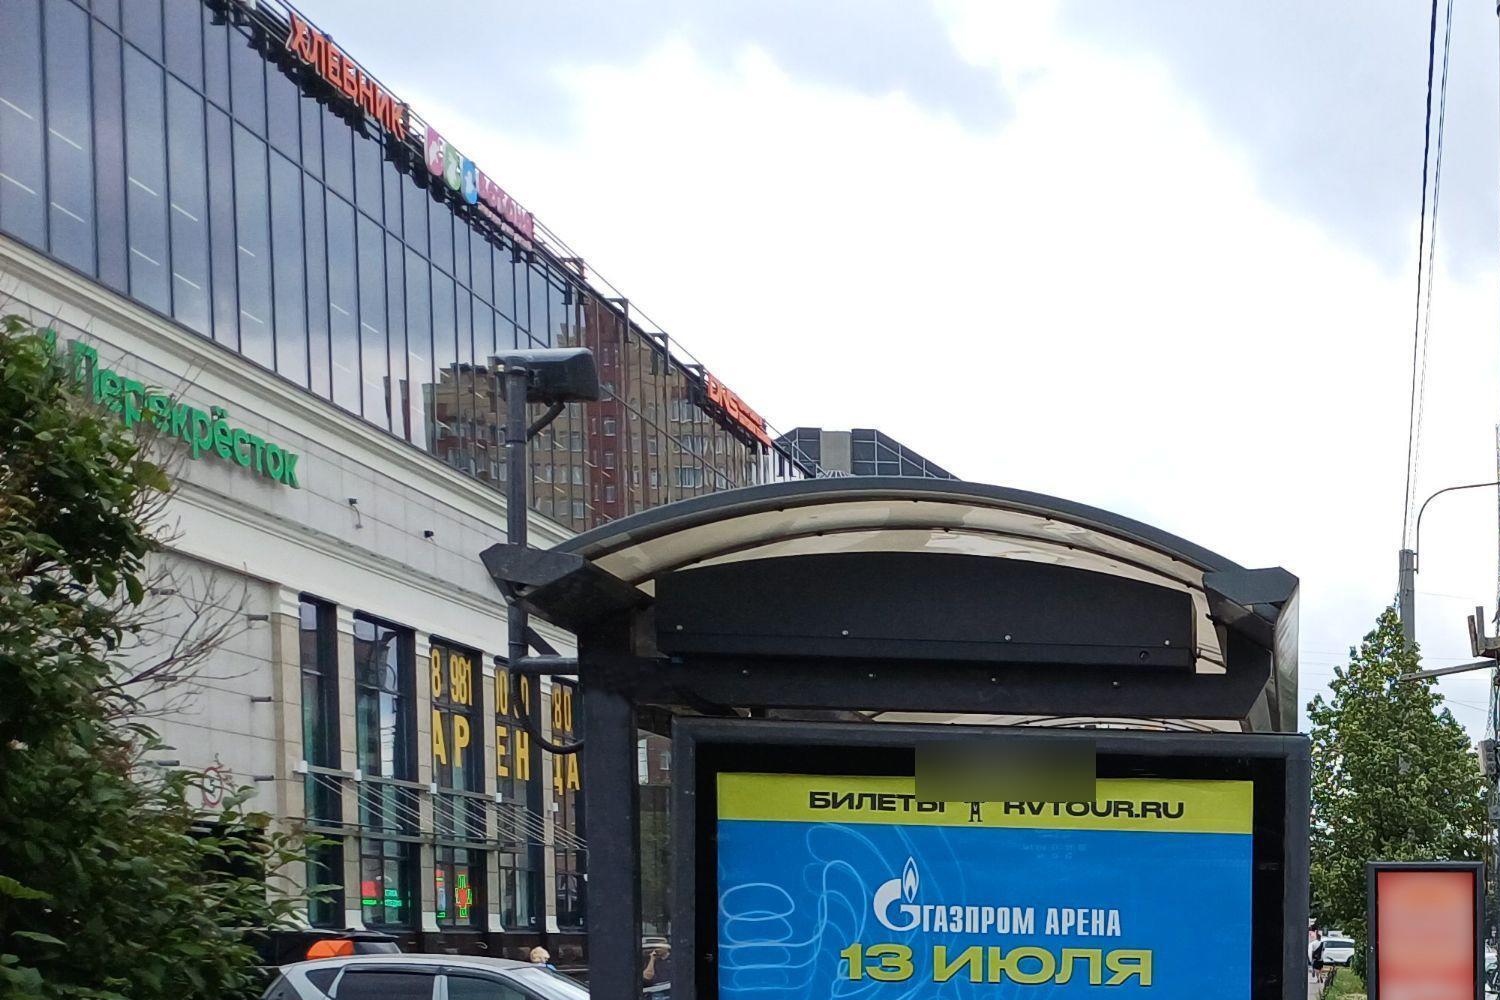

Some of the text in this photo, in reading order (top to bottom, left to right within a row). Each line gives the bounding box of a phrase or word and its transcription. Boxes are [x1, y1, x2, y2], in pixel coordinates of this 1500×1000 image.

[285, 11, 408, 142] ХЛЕБНИК
[68, 339, 300, 489] Перекрёсток
[450, 654, 473, 706] 981
[809, 791, 1184, 819] БИЛЕТЫ RVTOUR.RU
[923, 905, 1121, 937] ГАЗПРОМ АРЕНА
[840, 943, 1153, 987] 13 ИЮЛЯ
